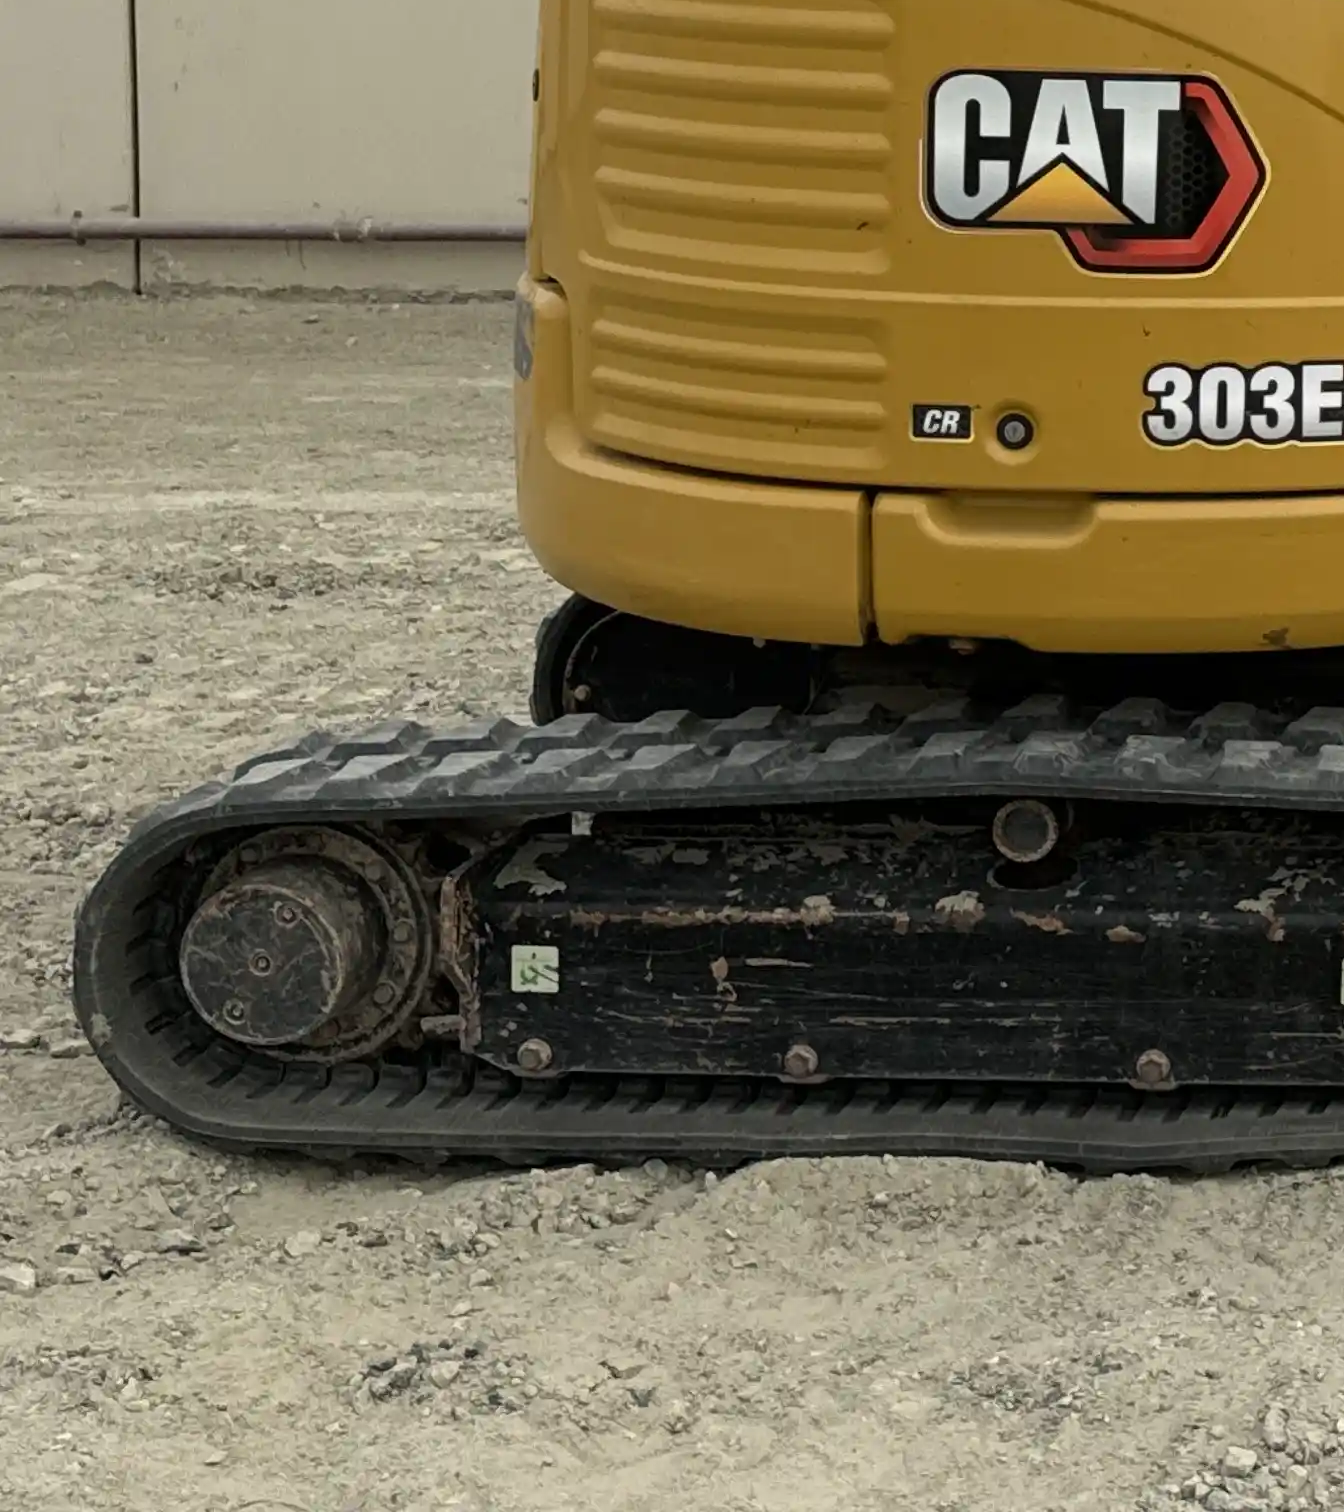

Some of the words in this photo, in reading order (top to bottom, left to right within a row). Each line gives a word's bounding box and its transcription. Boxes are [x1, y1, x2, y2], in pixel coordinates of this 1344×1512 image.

[934, 74, 1181, 224] CAT
[922, 409, 960, 434] CR
[1147, 364, 1343, 440] 303E
